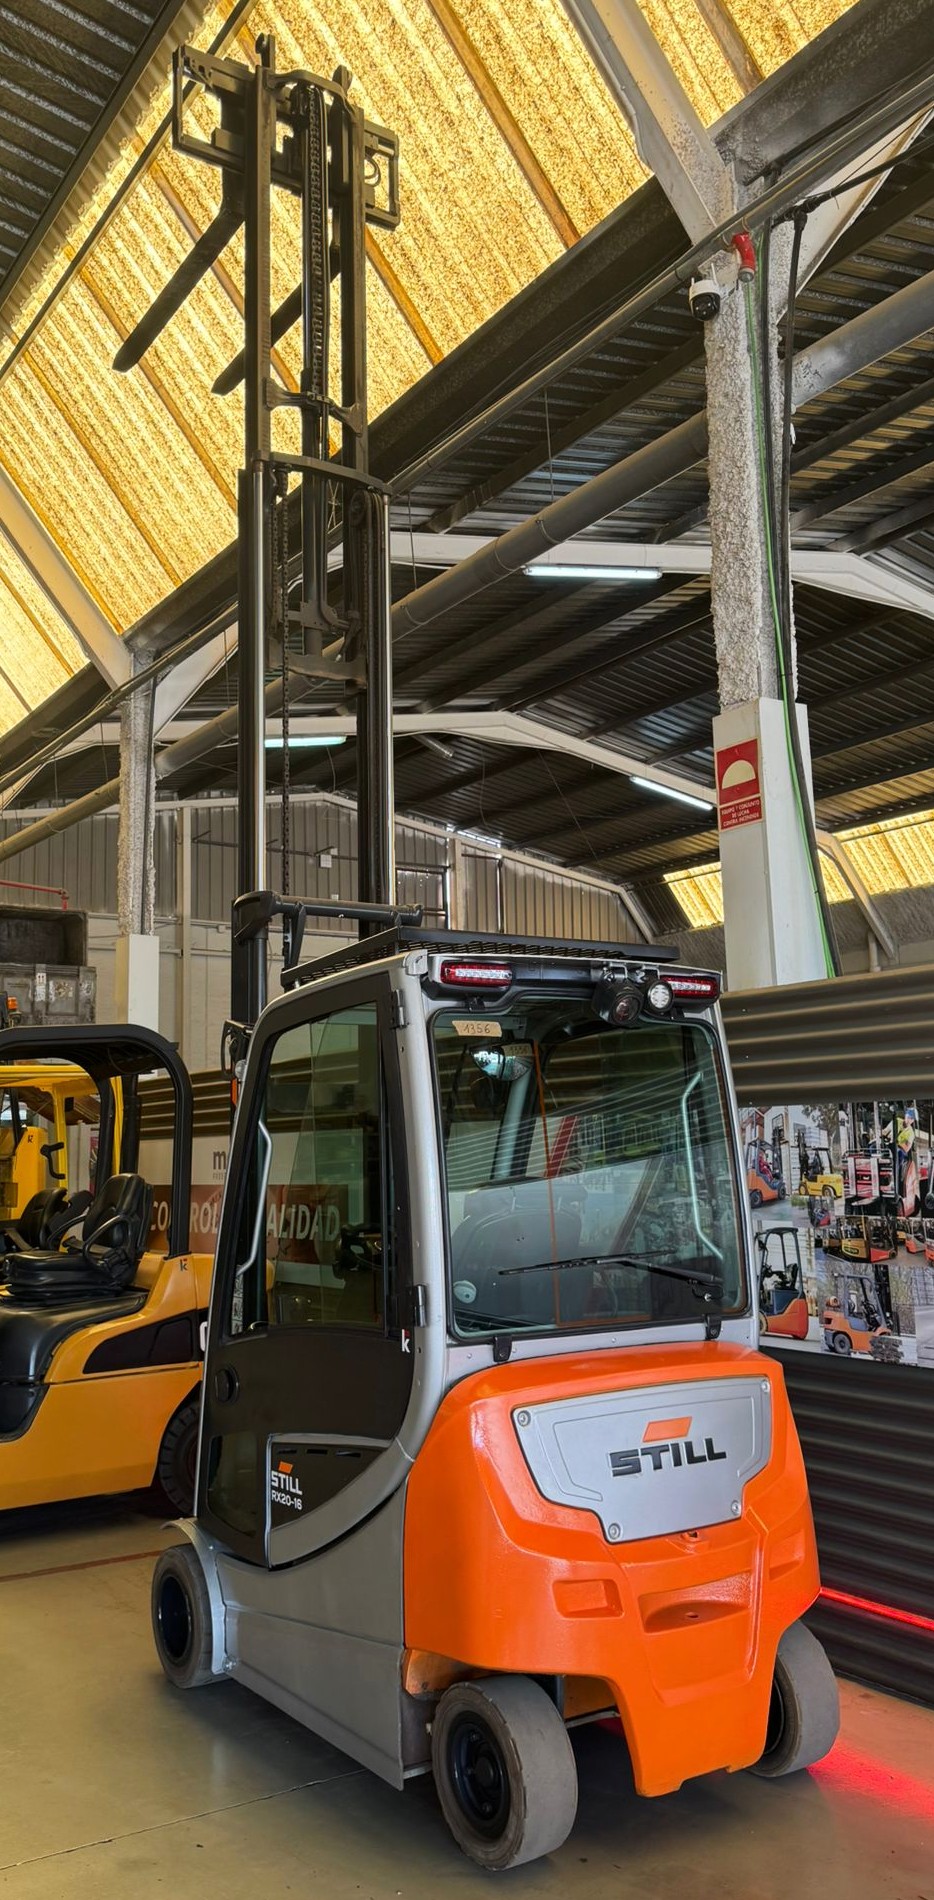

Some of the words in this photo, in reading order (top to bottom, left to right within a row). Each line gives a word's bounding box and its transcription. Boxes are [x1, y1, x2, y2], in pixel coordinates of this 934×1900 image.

[463, 1023, 490, 1034] 1356
[266, 1202, 341, 1242] ALIDAD
[401, 1329, 410, 1353] k
[609, 1437, 727, 1477] STILL
[271, 1470, 303, 1496] STILL
